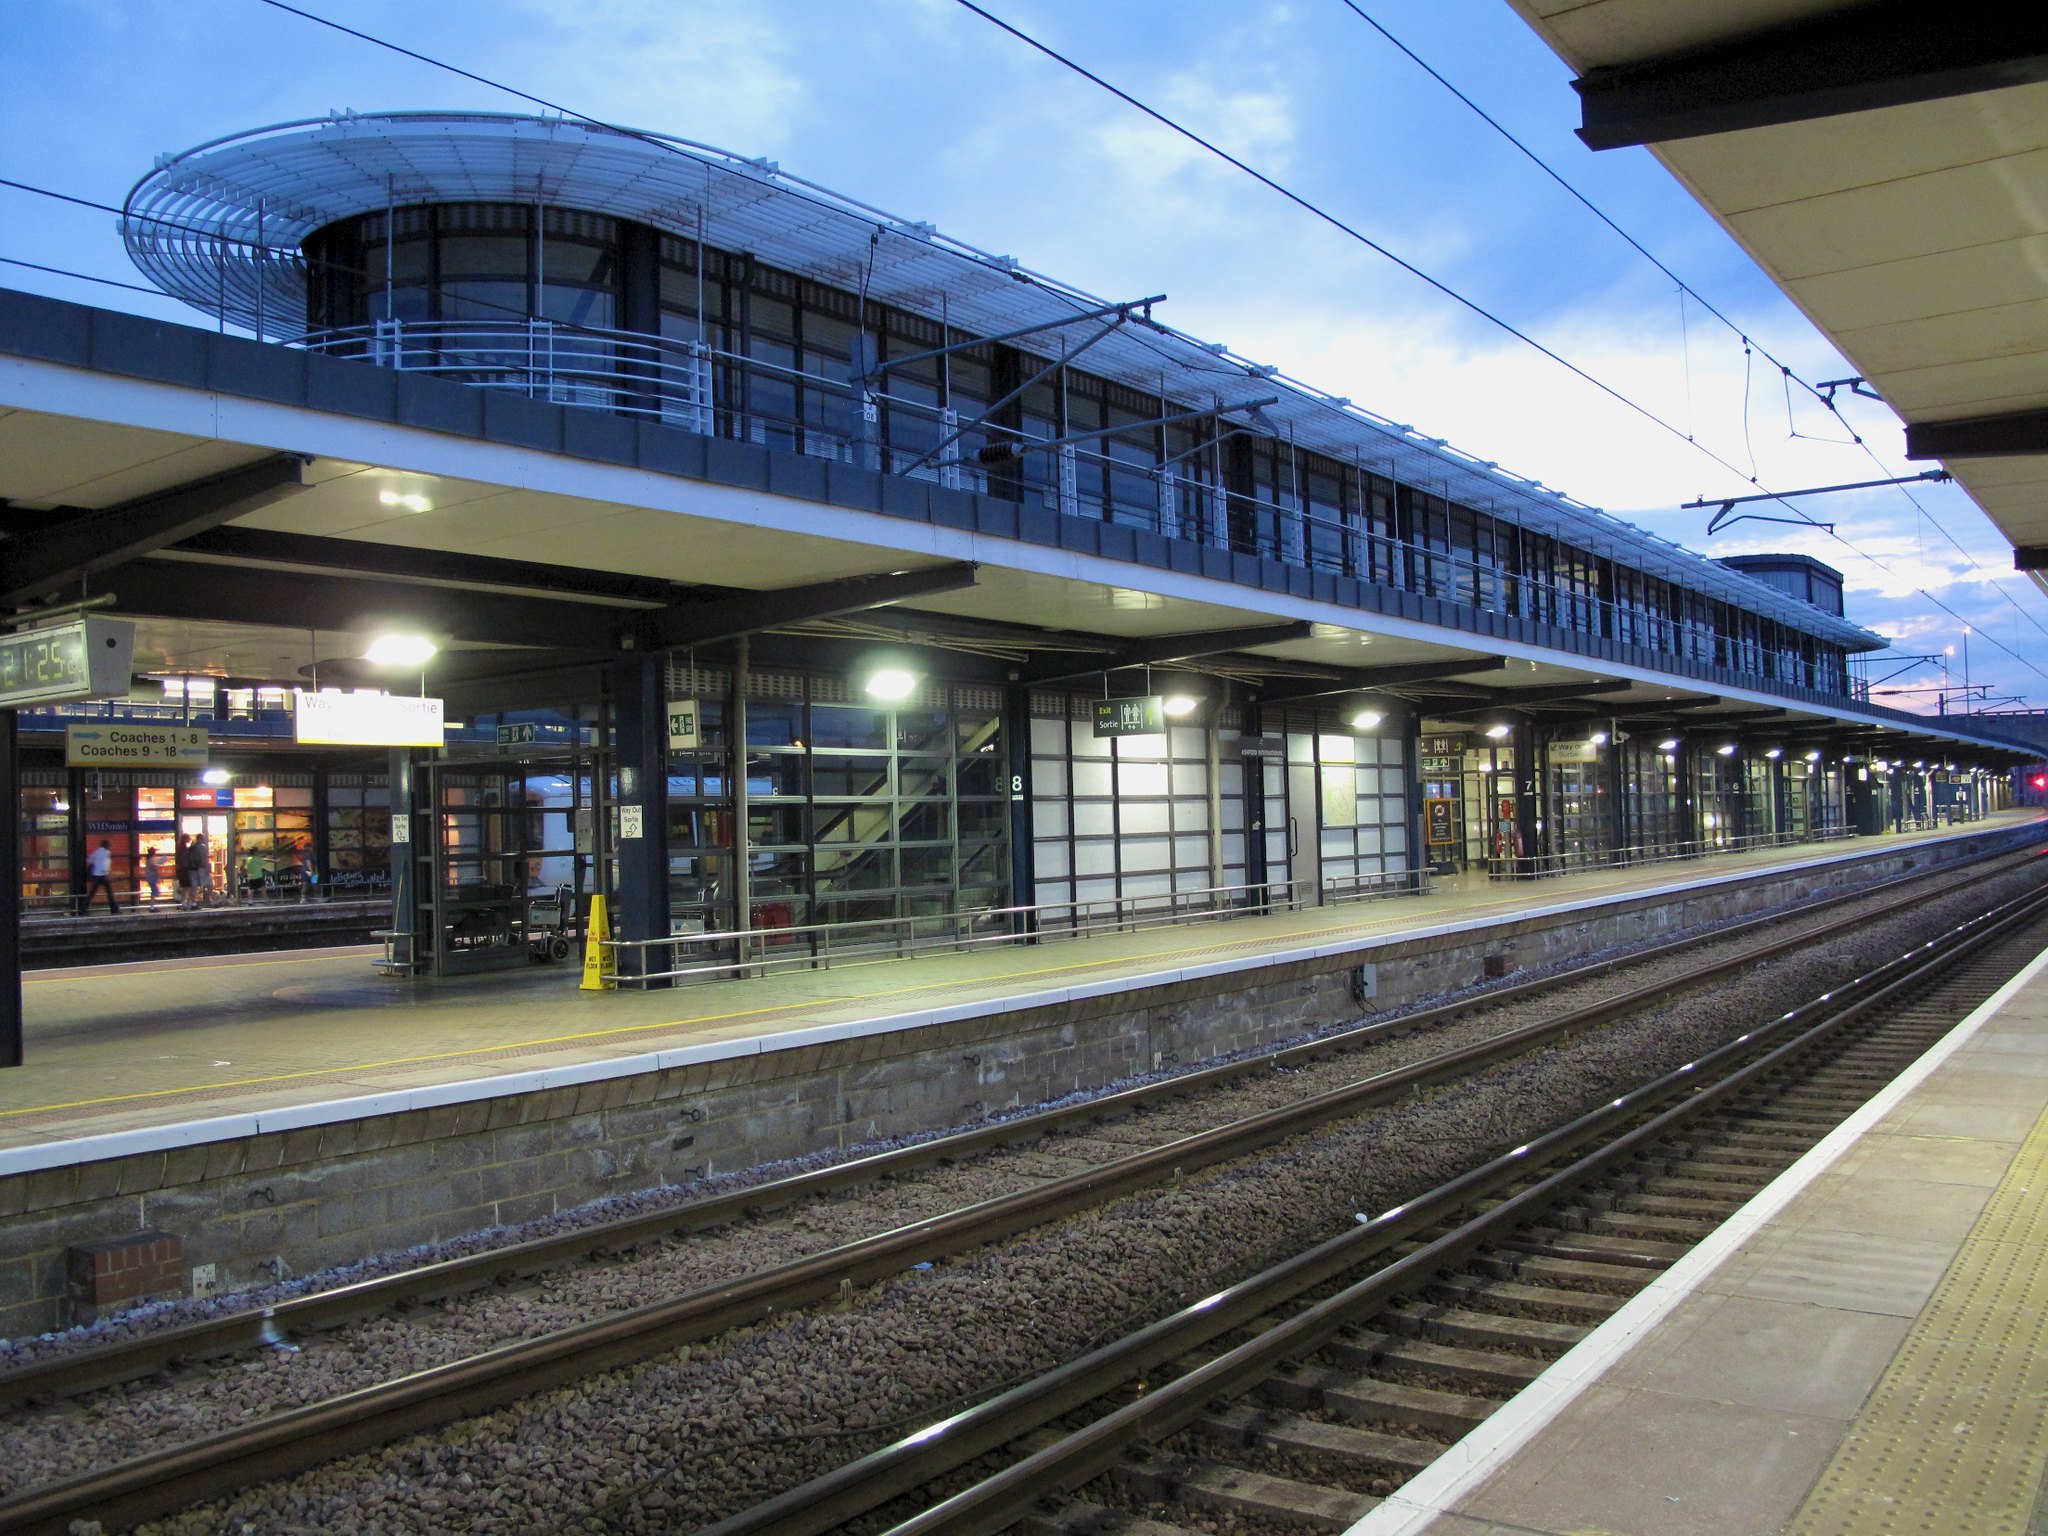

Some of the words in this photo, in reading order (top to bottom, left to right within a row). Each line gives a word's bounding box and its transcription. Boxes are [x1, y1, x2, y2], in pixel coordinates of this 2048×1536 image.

[399, 700, 438, 715] Sortie
[1098, 707, 1112, 715] Exit
[1099, 720, 1119, 729] Sortie
[110, 731, 166, 744] Coaches
[170, 733, 177, 744] 1
[190, 733, 199, 744] 8
[81, 744, 138, 757] Coaches
[142, 745, 151, 757] 9
[164, 746, 177, 757] 18
[1012, 775, 1022, 791] 8
[1525, 781, 1532, 791] 7
[1732, 782, 1739, 790] 6
[632, 806, 642, 814] Out
[602, 955, 611, 963] WET
